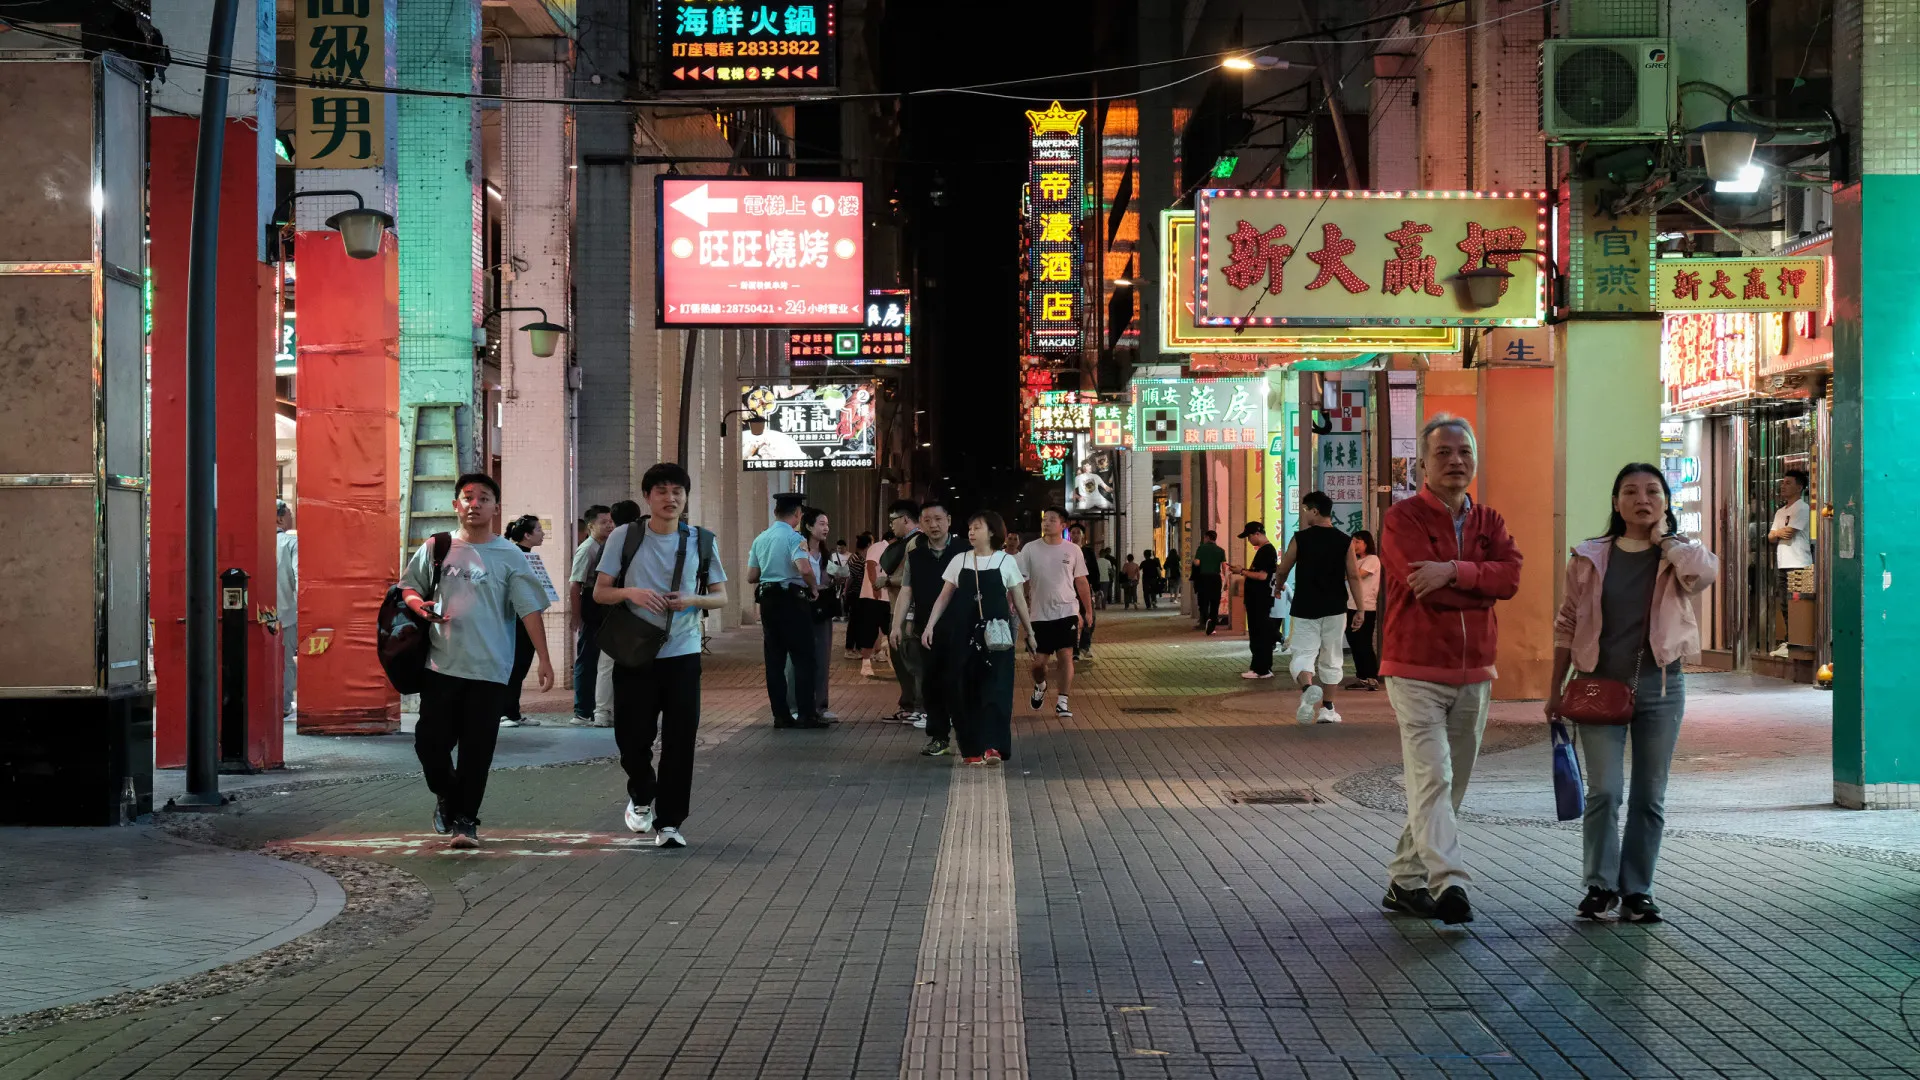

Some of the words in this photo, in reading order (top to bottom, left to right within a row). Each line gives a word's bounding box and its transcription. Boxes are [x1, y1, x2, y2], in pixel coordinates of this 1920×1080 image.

[676, 6, 816, 36] 海鮮火鍋
[672, 43, 734, 57] 訂座電話
[737, 41, 820, 56] 28333822
[1032, 140, 1079, 148] EMPEROR
[1040, 150, 1071, 158] HOTEL
[698, 229, 830, 269] 旺旺燒烤
[1040, 172, 1073, 322] 帝濠酒店
[1038, 338, 1076, 347] MACAU
[1504, 338, 1542, 362] 生
[1094, 405, 1122, 420] 順安
[1142, 386, 1181, 406] 順安
[1184, 384, 1258, 426] 藥房
[1184, 428, 1257, 444] 政府註冊
[1041, 445, 1066, 458] 金沙
[1323, 440, 1363, 468] 順安藥
[783, 460, 825, 468] 28382818
[831, 459, 872, 467] 65800469
